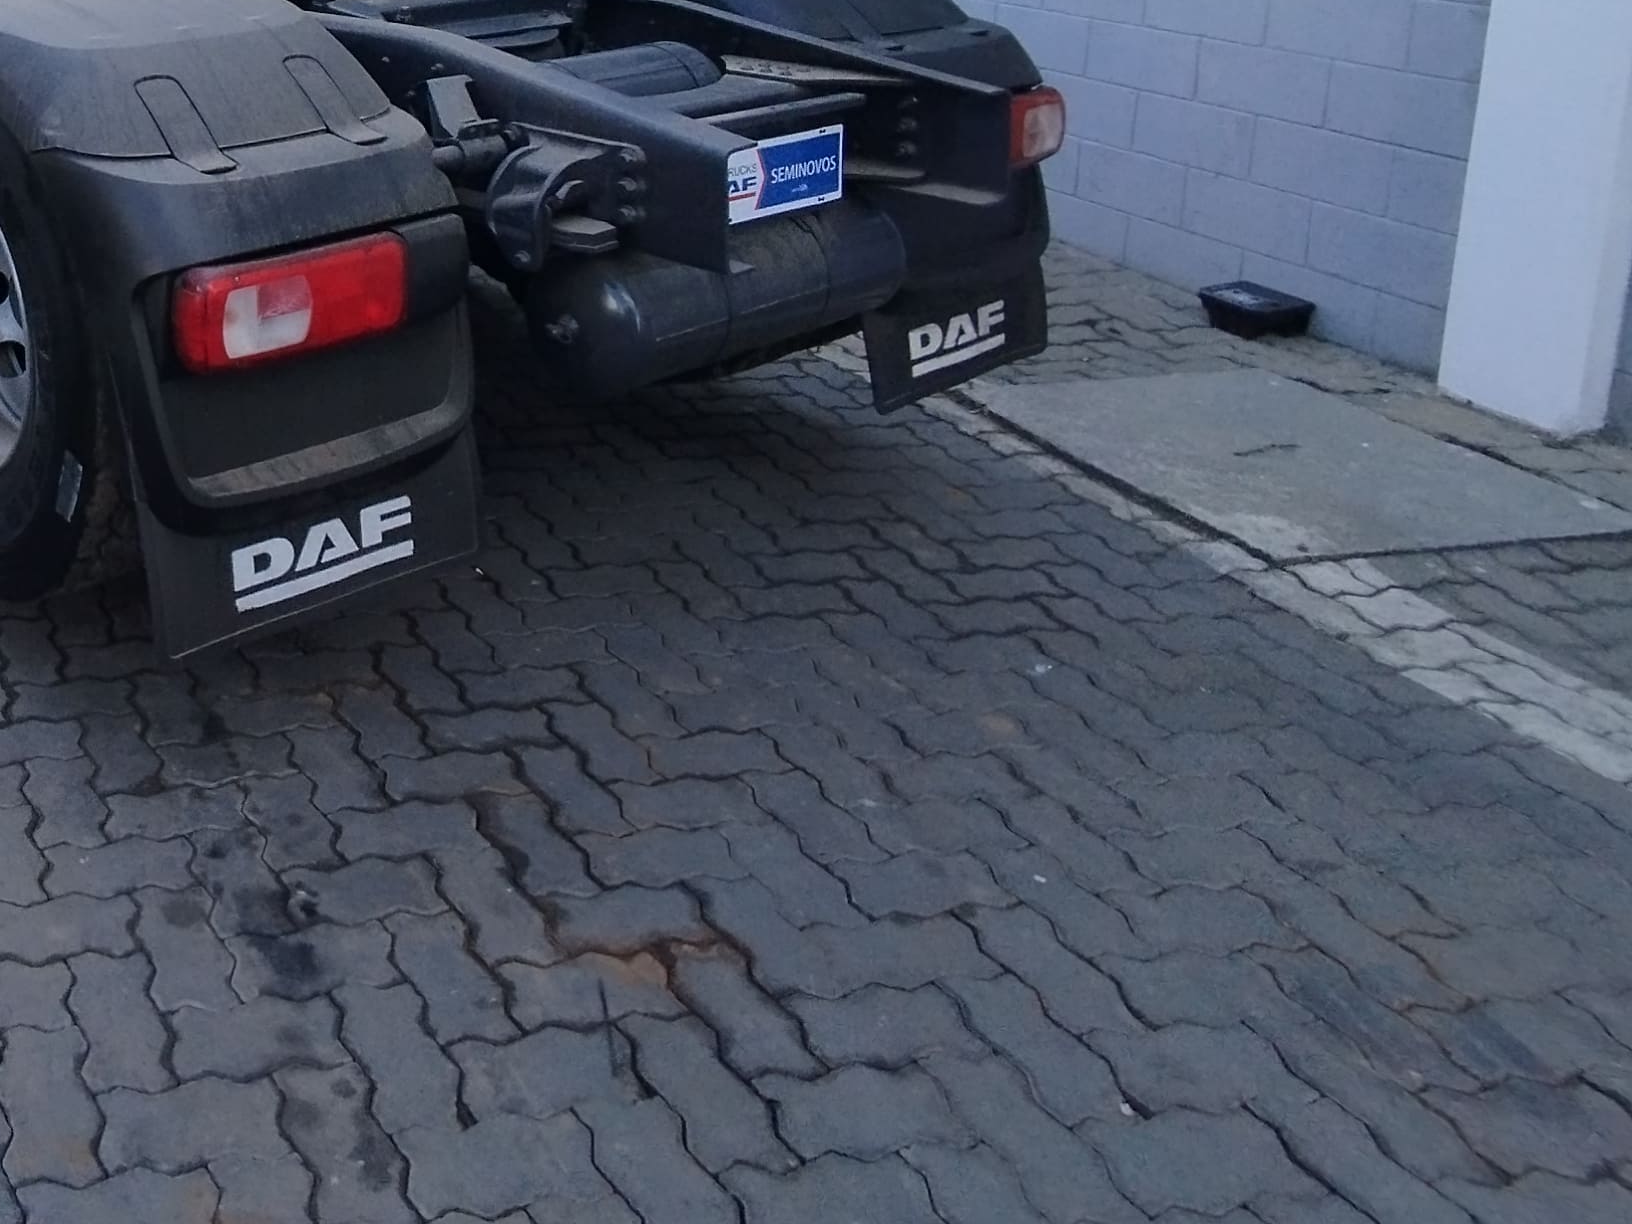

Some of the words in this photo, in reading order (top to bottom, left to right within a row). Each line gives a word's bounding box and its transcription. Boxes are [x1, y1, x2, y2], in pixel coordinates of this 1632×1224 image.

[728, 163, 757, 177] RUCKS
[770, 154, 837, 184] SEMINOVOS
[728, 176, 757, 194] AF
[907, 299, 1005, 361] DAF
[231, 495, 412, 593] DAF
